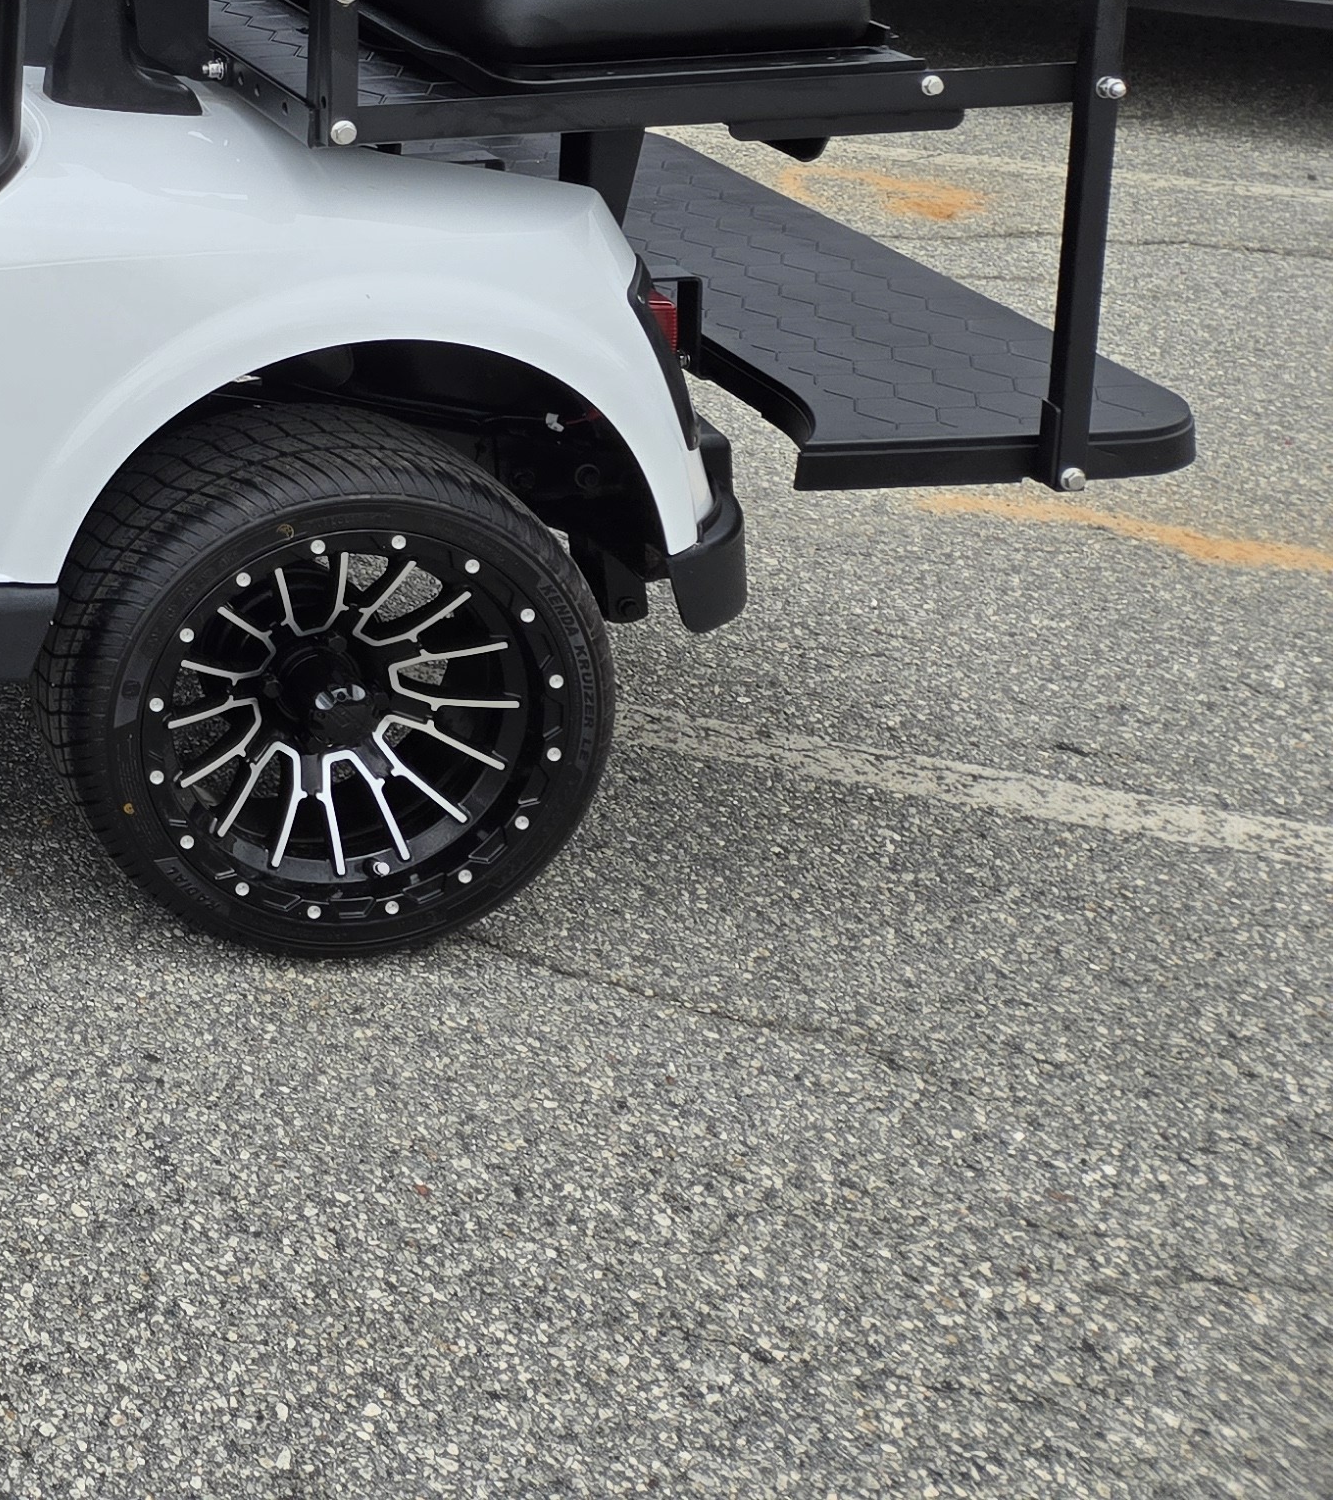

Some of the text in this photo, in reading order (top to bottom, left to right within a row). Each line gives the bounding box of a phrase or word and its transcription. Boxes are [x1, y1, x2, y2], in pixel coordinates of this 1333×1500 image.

[540, 585, 579, 637] KENDA
[574, 645, 593, 728] KRUIZER
[166, 867, 221, 909] RADIAL
